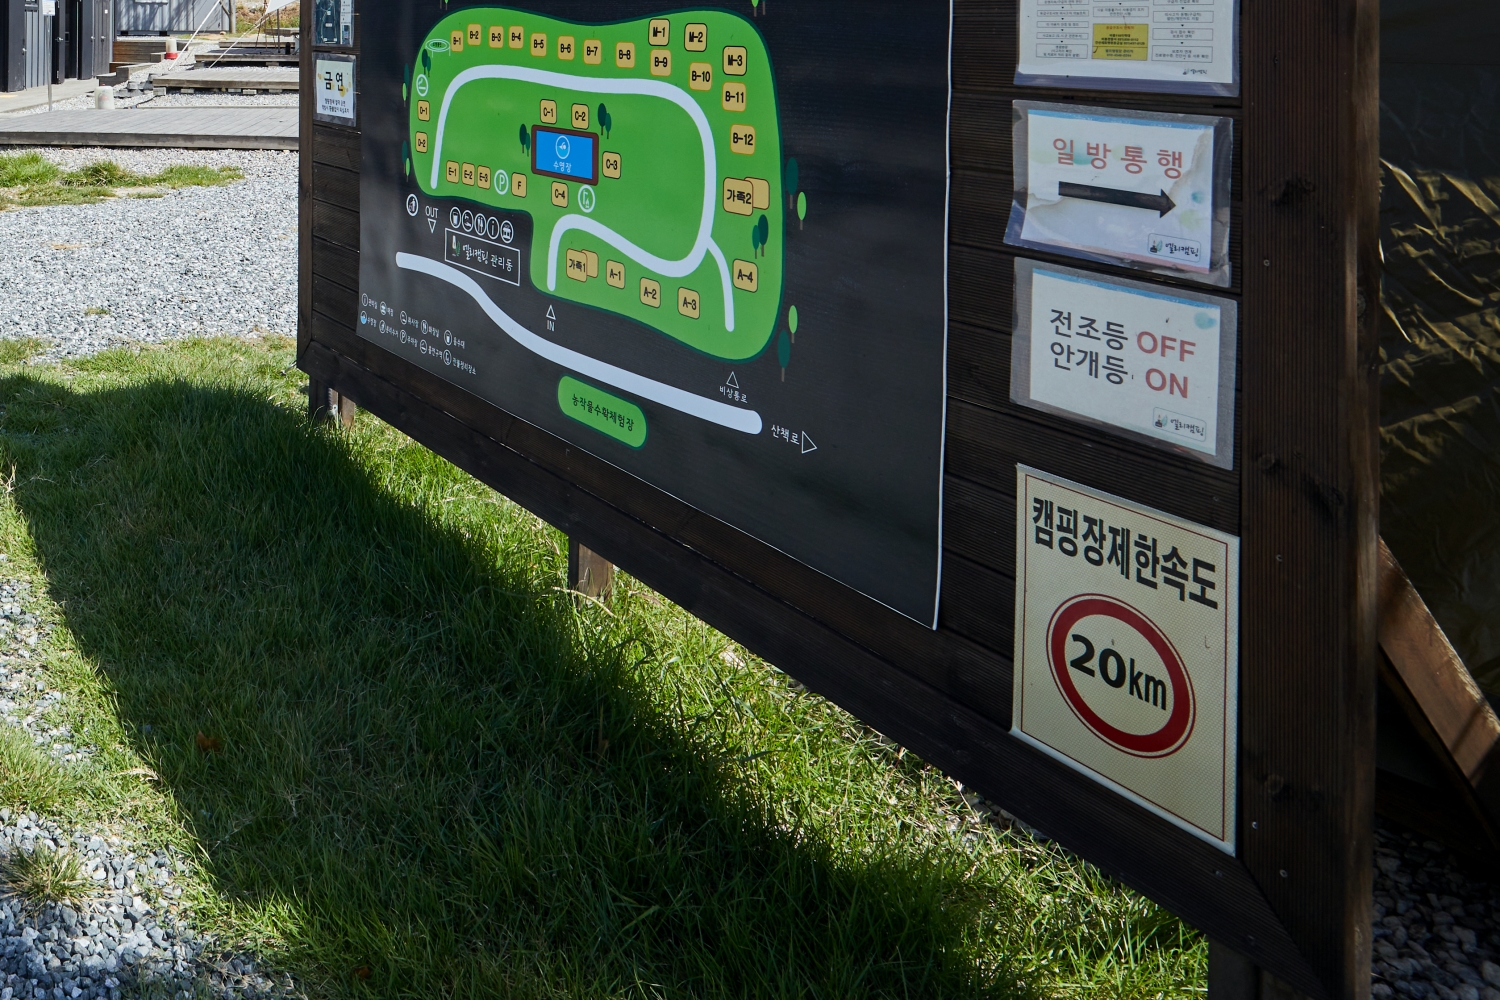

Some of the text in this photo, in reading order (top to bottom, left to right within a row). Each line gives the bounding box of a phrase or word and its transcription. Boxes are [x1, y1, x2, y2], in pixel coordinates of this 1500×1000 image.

[469, 30, 479, 40] B-2
[491, 32, 501, 42] B-3
[511, 32, 521, 42] B-4
[652, 27, 666, 38] M-1
[688, 31, 703, 43] M-2
[453, 36, 461, 45] B-1
[533, 38, 544, 49] B-5
[560, 43, 571, 53] B-6
[586, 46, 598, 57] B-7
[618, 49, 631, 60] B-8
[654, 56, 668, 67] B-9
[727, 55, 743, 67] M-3
[691, 70, 711, 82] B-10
[725, 90, 744, 103] B-11
[543, 107, 554, 118] C-1
[574, 110, 586, 122] C-2
[732, 132, 754, 146] B-12
[553, 160, 572, 173] 수영장
[605, 158, 618, 170] C-3
[448, 166, 457, 177] E-1
[463, 169, 473, 179] E-2
[479, 172, 488, 182] E-3
[517, 181, 522, 190] F
[554, 188, 566, 200] C-4
[726, 188, 752, 205] 가족2
[425, 205, 439, 219] OUT
[1165, 242, 1199, 258] 엘리캠핑
[462, 244, 514, 272] 엘리캠핑 관리동
[568, 258, 586, 273] 가족1
[609, 268, 621, 281] A-1
[737, 269, 754, 283] A-4
[643, 286, 657, 300] A-2
[682, 296, 697, 311] A-3
[546, 320, 555, 332] IN
[1050, 308, 1196, 362] 전조등 OFF
[1050, 341, 1188, 399] 안개등 ON
[719, 385, 748, 404] 비상통로
[571, 393, 635, 432] 농작물수확체험장
[1170, 417, 1205, 437] 엘리캠핑
[770, 424, 800, 445] 산책로
[1032, 496, 1218, 610] 캠핑장제한속도
[1069, 633, 1167, 711] 20km
